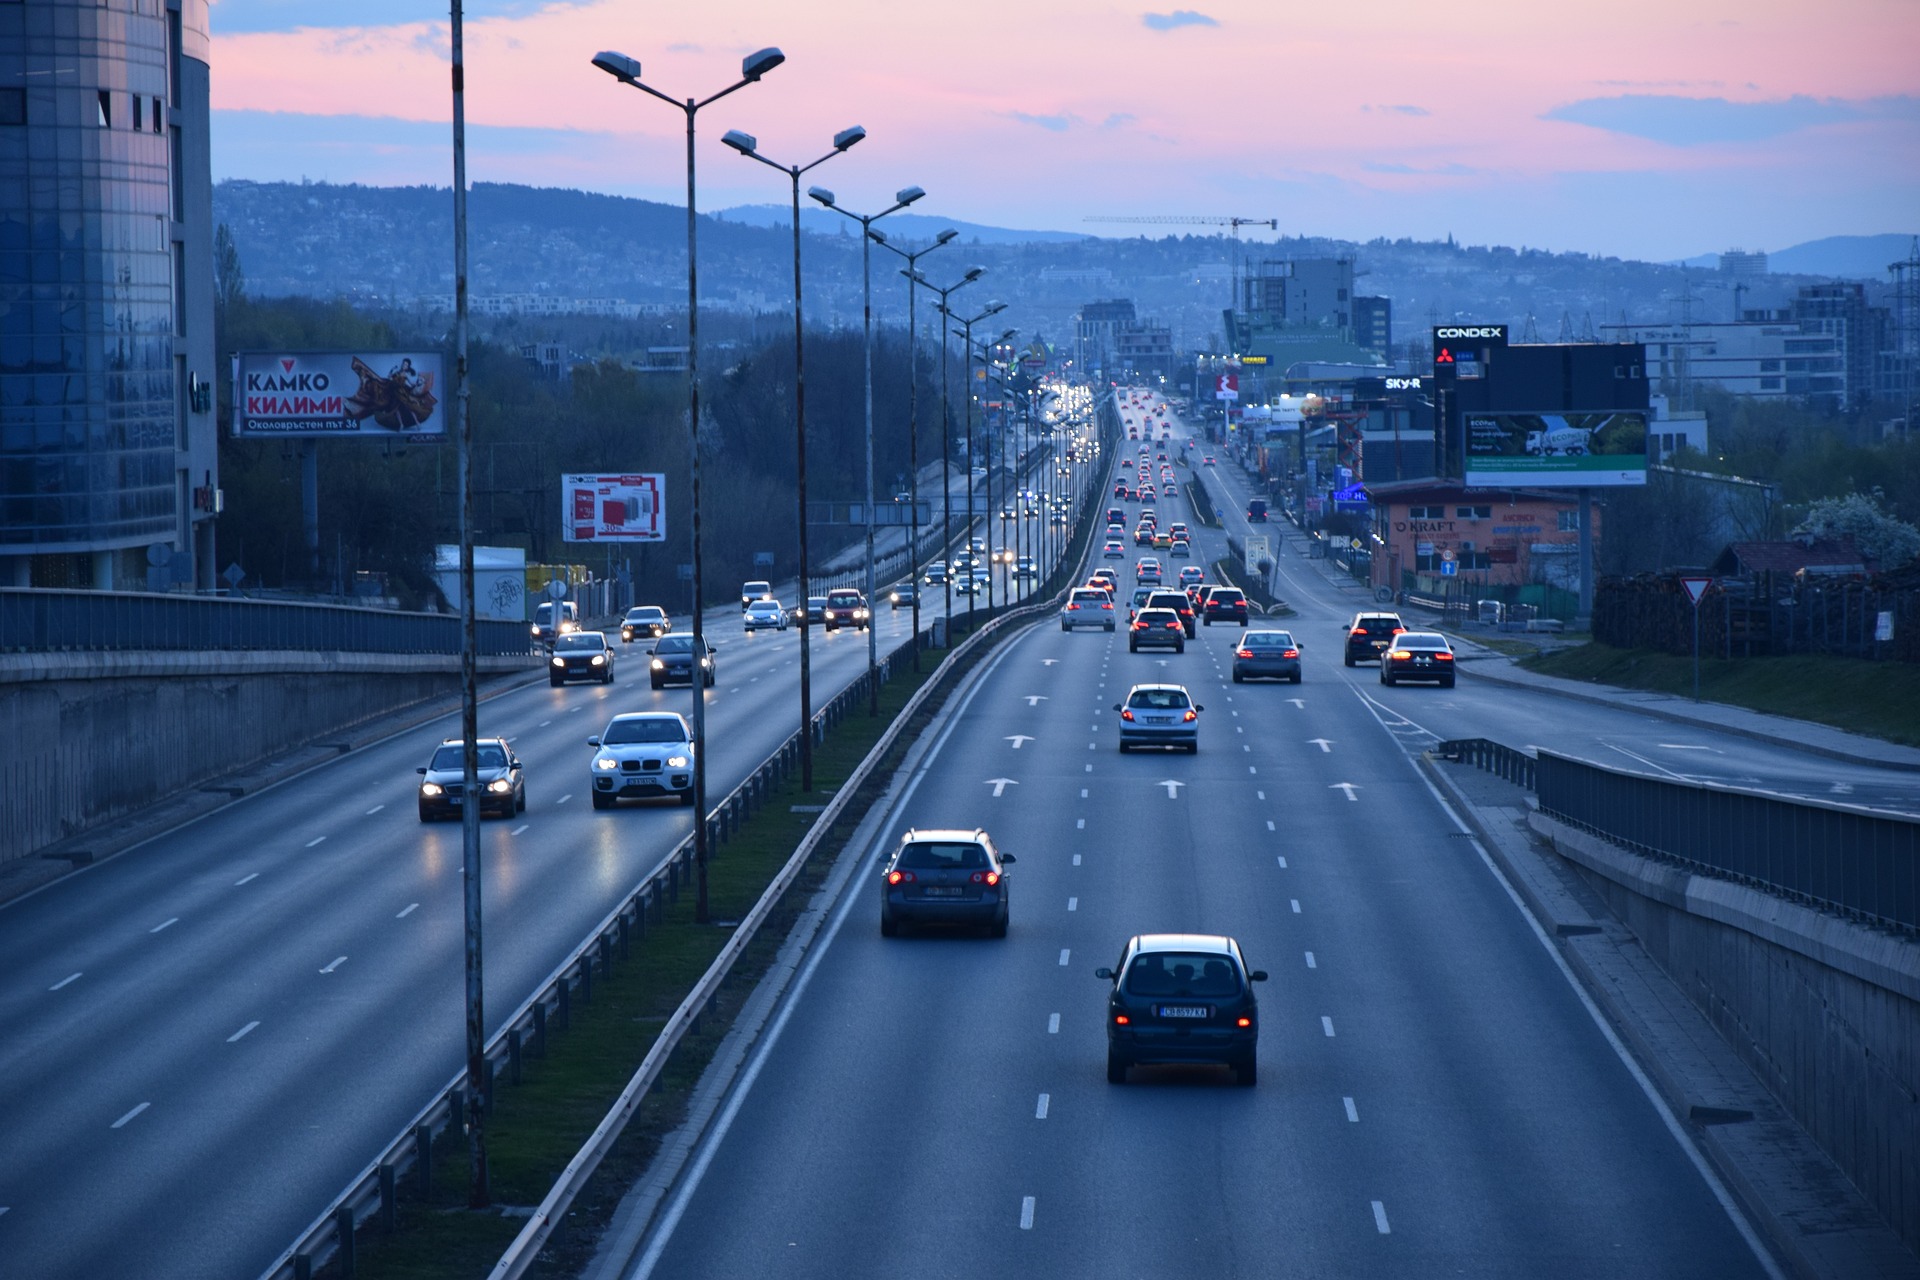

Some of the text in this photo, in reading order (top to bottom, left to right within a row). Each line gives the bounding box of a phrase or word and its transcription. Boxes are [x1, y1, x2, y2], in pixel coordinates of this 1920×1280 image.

[1437, 327, 1501, 338] CONDEX
[247, 373, 329, 391] КАМКО
[247, 397, 342, 414] КИЛИМИ
[247, 419, 358, 432] Околовръстен път 36
[1410, 521, 1456, 532] KRAFT
